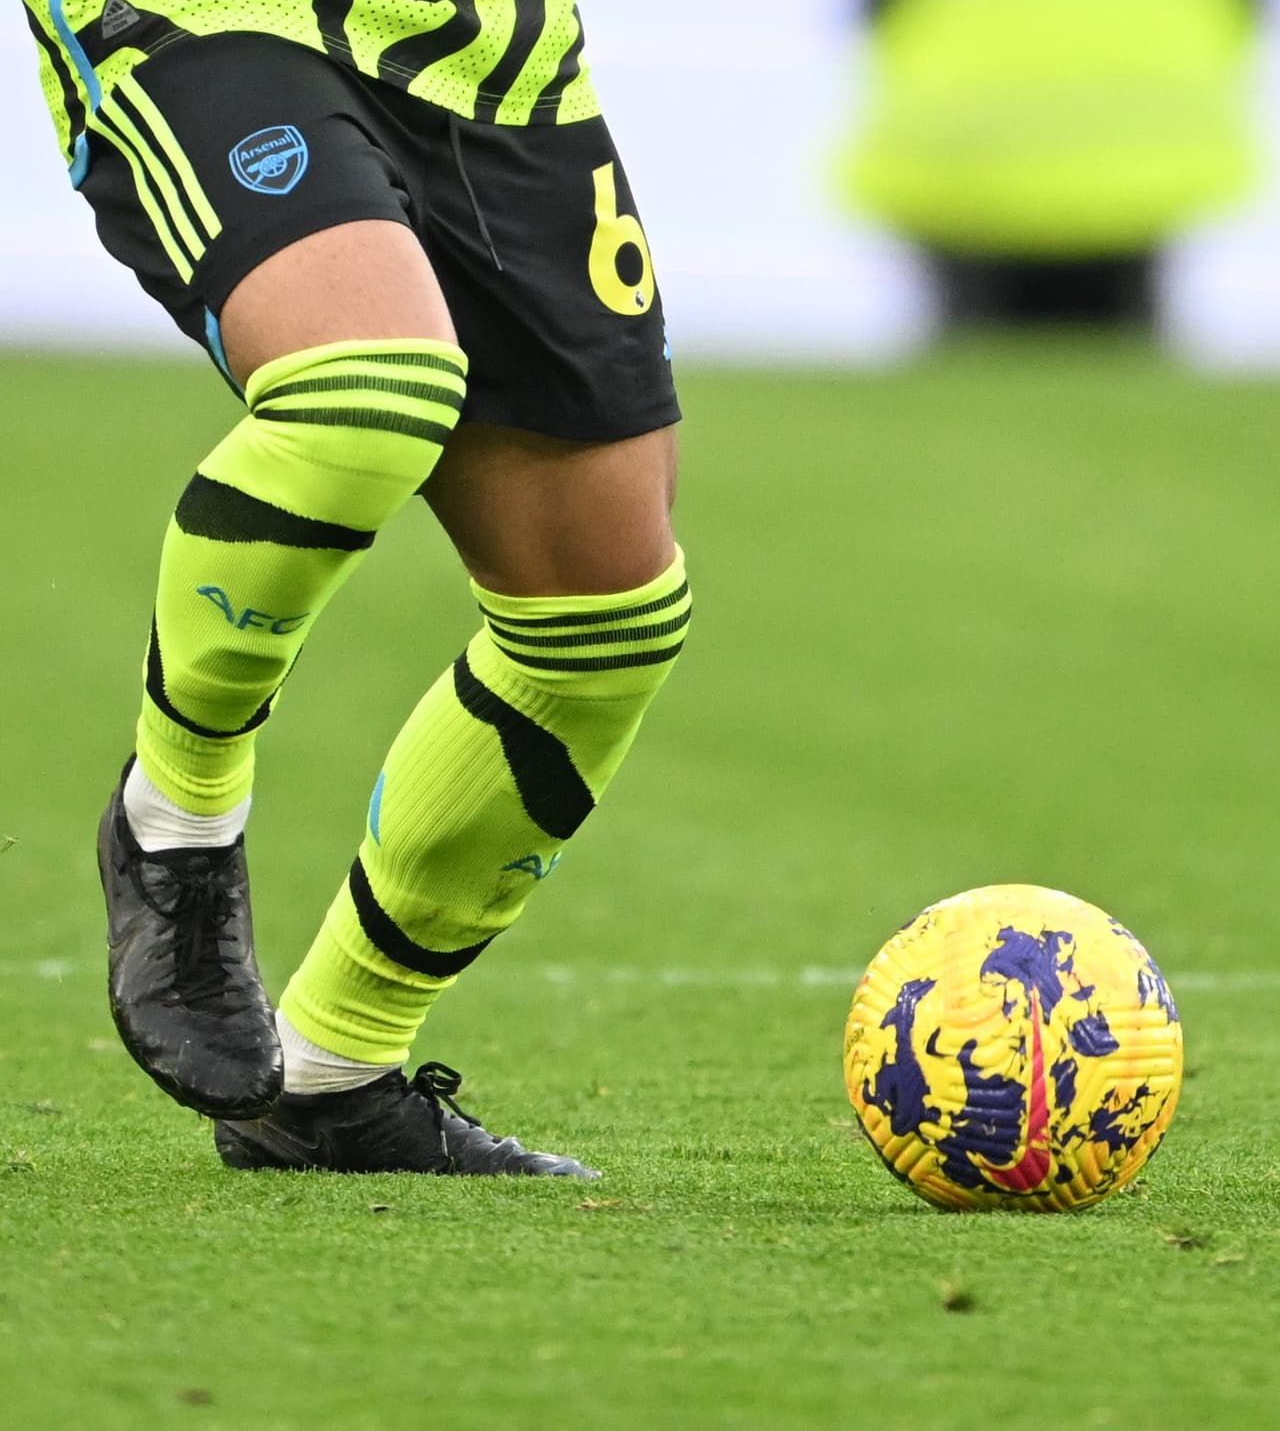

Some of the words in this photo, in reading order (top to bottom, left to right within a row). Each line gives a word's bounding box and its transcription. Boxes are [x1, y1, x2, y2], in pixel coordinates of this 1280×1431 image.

[240, 133, 293, 163] Arsenal
[588, 160, 655, 316] 6
[196, 585, 312, 636] AFC
